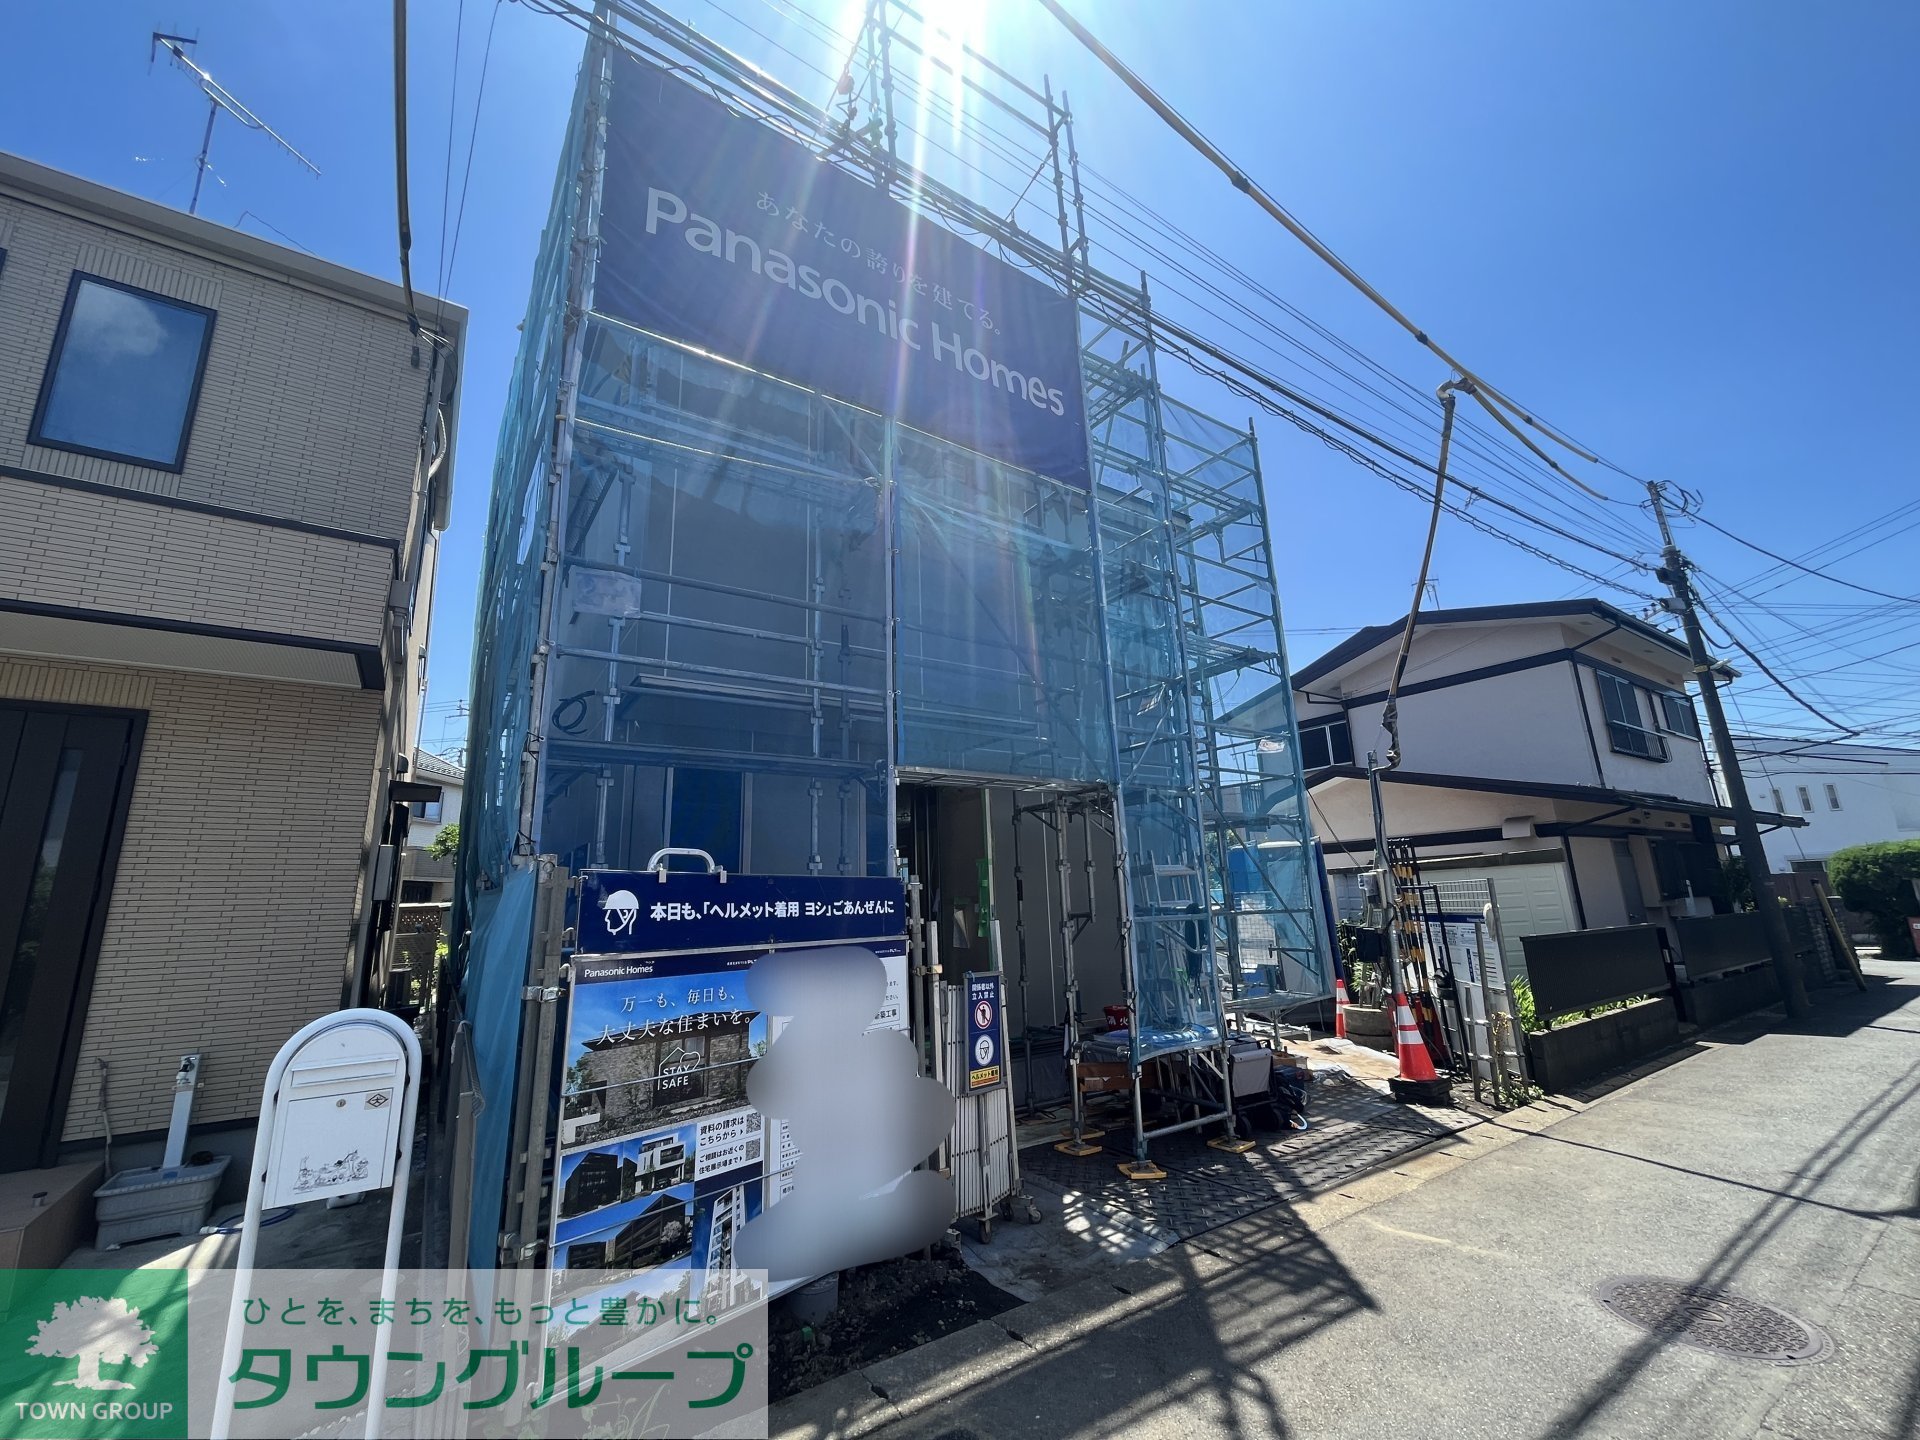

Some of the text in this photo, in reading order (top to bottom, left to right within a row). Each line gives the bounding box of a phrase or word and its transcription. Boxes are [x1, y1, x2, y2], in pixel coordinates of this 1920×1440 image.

[757, 191, 1001, 336] あなたの誇りを建てる。
[645, 187, 1065, 417] Panasonic Homes
[650, 900, 894, 921] 本日も、「ヘルメット着用 ヨシ」ごあんぜんに
[584, 965, 653, 978] Panasonic Homes
[621, 986, 735, 1013] 万一も、 毎日も、
[596, 1008, 751, 1046] 大丈夫な住まいを。
[663, 1063, 690, 1076] STAY
[662, 1075, 689, 1090] SAFE
[700, 1116, 744, 1135] 資料の請求は
[700, 1129, 737, 1147] こちらから
[700, 1145, 744, 1163] ご相談はお近くの
